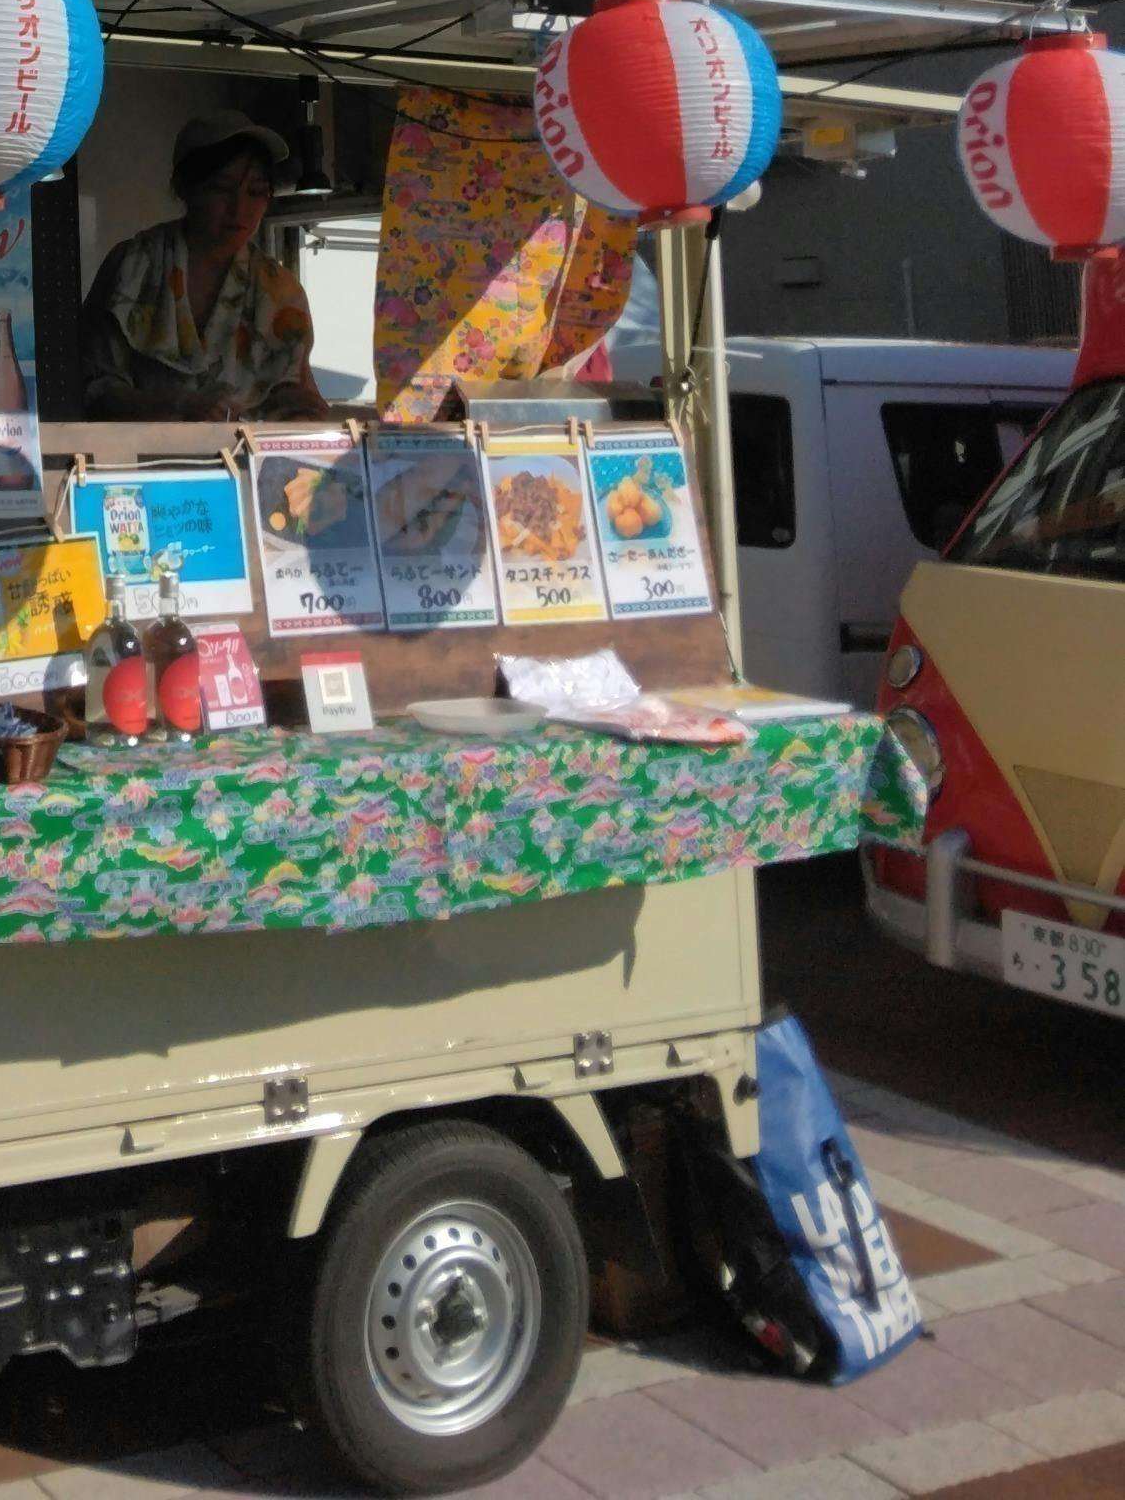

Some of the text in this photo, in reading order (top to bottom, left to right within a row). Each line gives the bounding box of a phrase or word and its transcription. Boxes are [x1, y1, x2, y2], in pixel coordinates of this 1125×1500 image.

[536, 40, 585, 179] Orion
[688, 16, 734, 160] オリオンビール
[964, 81, 1014, 210] Orion
[505, 564, 593, 583] タコスチップス
[321, 703, 357, 717] PayPay
